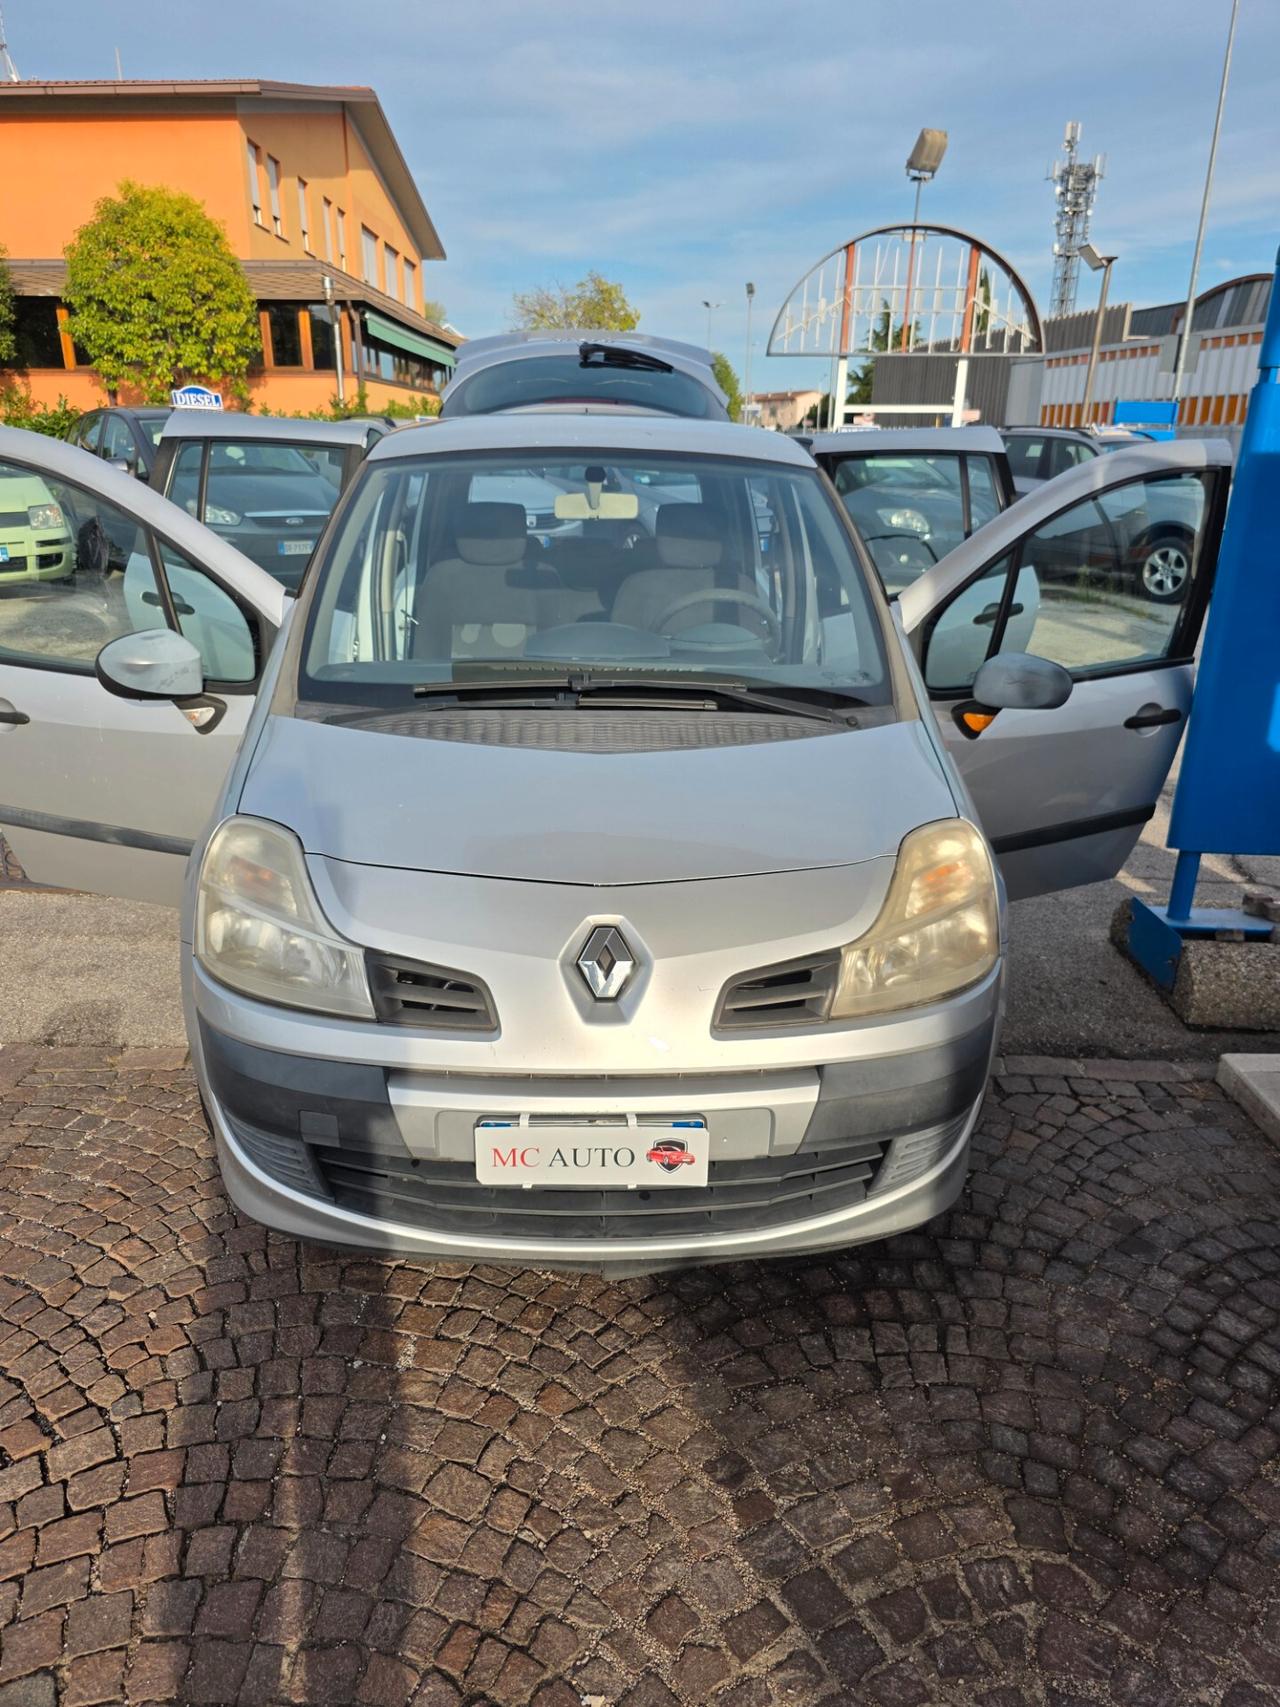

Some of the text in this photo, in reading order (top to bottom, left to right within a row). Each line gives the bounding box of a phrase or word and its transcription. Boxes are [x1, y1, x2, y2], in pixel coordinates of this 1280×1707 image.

[175, 392, 219, 407] DIESEL
[491, 1147, 636, 1168] MC AUTO
